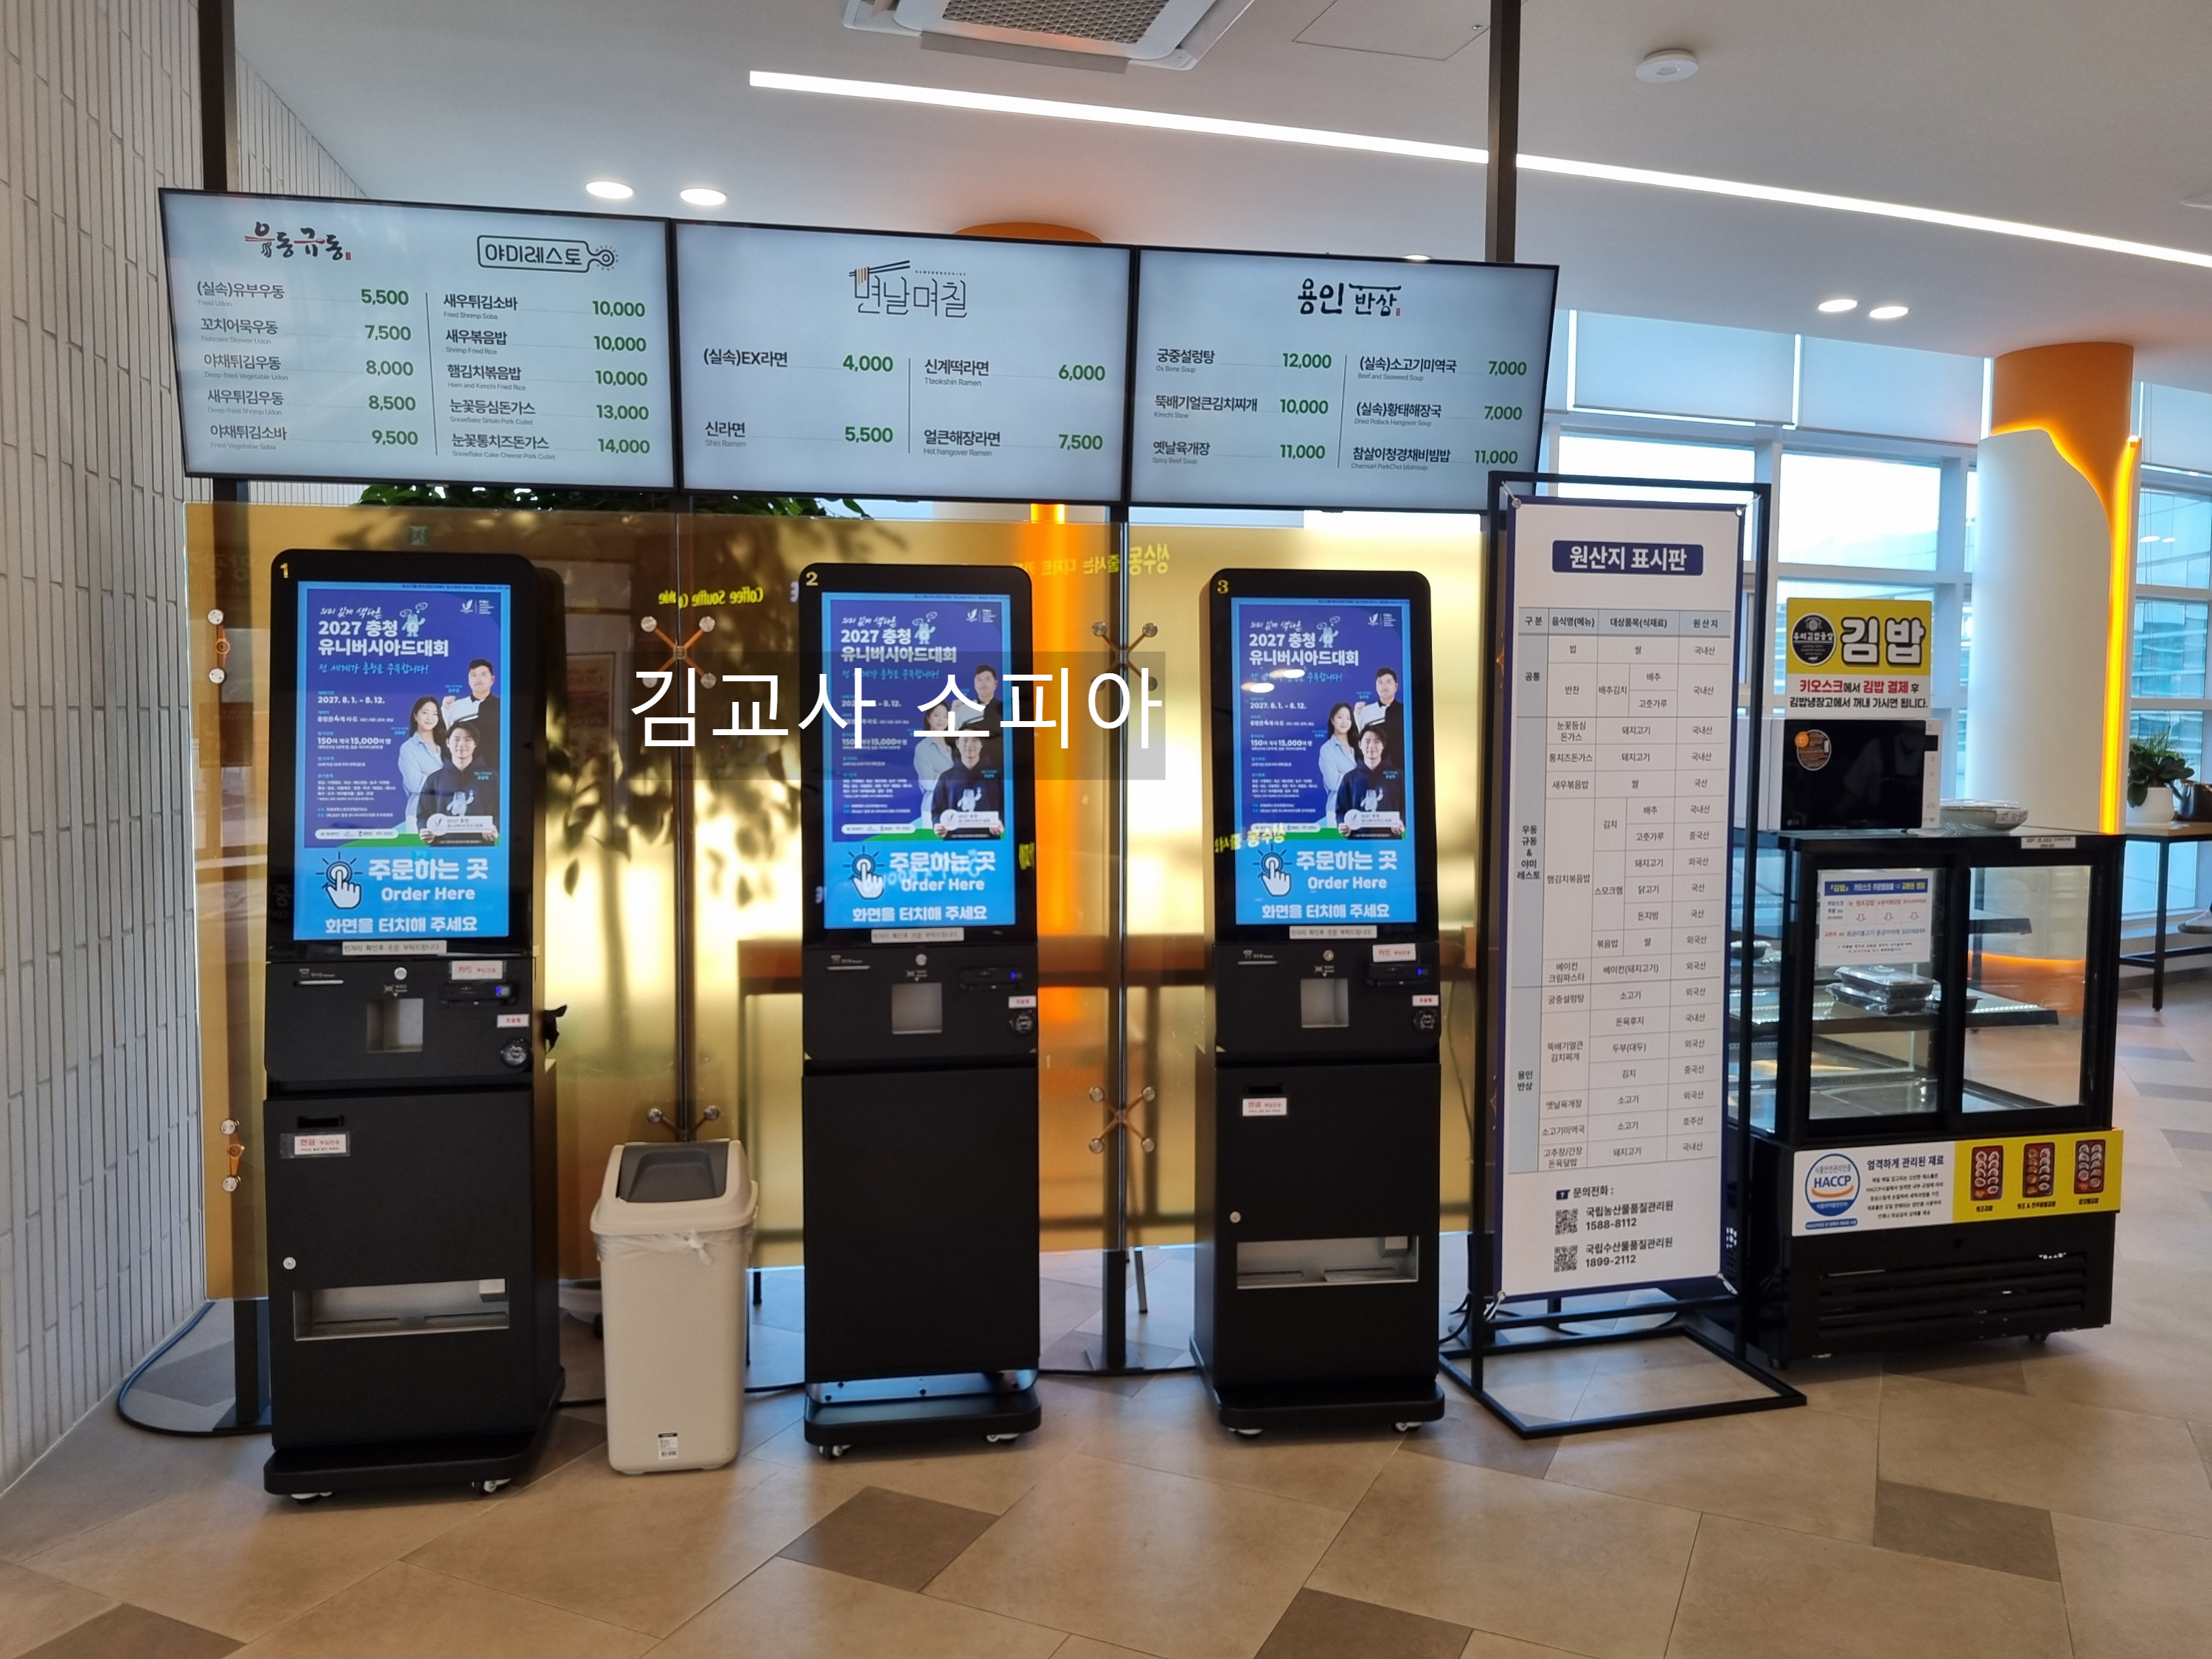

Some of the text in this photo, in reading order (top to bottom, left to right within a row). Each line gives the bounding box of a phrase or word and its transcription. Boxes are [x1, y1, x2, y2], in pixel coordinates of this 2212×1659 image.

[485, 244, 582, 265] 야미레스토
[197, 281, 285, 299] (실속)유부우동
[361, 289, 408, 305] 5,500
[853, 265, 967, 318] 면날며칠
[1298, 278, 1400, 317] 용인 반상
[443, 293, 518, 311] 새우튀김소바
[593, 301, 645, 317] 10,000
[201, 319, 278, 334] 꼬치어묵우동
[365, 325, 411, 341] 7,500
[446, 330, 507, 345] 새우볶음밥
[594, 336, 647, 352] 10,000
[204, 354, 281, 370] 야채튀김우동
[704, 348, 787, 367] (실속)EX라면
[843, 355, 893, 372] 4,000
[1157, 349, 1215, 364] 궁중설렁탕
[1283, 353, 1332, 369] 12,000
[366, 361, 414, 376] 8,000
[448, 364, 521, 380] 햄김치볶음밥
[925, 359, 989, 377] 신계떡라면
[1360, 356, 1457, 373] (실속)소고기미역국
[1489, 361, 1526, 376] 7,000
[596, 370, 647, 386] 10,000
[1059, 364, 1105, 381] 6,000
[208, 390, 284, 406] 새우튀김우동
[369, 395, 416, 411] 8,500
[1155, 395, 1257, 411] 뚝배기얼큰김치찌개
[450, 399, 535, 414] 눈꽃등심돈가스
[597, 405, 649, 420] 13,000
[1280, 399, 1329, 414] 10,000
[1357, 402, 1441, 418] (실속)황태해장국
[1484, 406, 1522, 420] 7,000
[210, 425, 287, 441] 야채튀김소바
[705, 421, 745, 437] 신라면
[845, 426, 893, 443] 5,500
[372, 430, 418, 445] 9,500
[452, 434, 549, 450] 눈꽃통치즈돈가스
[924, 430, 1001, 446] 얼큰해장라면
[1059, 434, 1102, 451] 7,500
[598, 438, 650, 454] 14,000
[1153, 441, 1210, 456] 옛날육개장
[1280, 445, 1325, 459] 11,000
[1353, 448, 1451, 462] 참살이청경채비빔밥
[1475, 451, 1517, 465] 11,000
[1570, 546, 1686, 571] 원산지 표시판
[280, 563, 288, 578] 1
[806, 571, 818, 586] 2
[1217, 580, 1228, 594] 3
[319, 621, 397, 637] 2027 충청
[1551, 616, 1594, 627] 음식명(메뉴)
[1610, 618, 1667, 628] 대상품목(식재료)
[841, 629, 911, 644] 2027 충청
[1249, 633, 1315, 647] 2027 충청
[1841, 616, 1926, 666] 김밥
[319, 639, 448, 657] 유니버시아드대회
[841, 647, 956, 663] 유니버시아드대회
[1569, 644, 1576, 653] 밥
[1694, 646, 1715, 655] 국내산
[1249, 650, 1358, 666] 유니버시아드대회
[1525, 672, 1540, 681] 공통
[1646, 672, 1660, 681] 배추
[1565, 686, 1579, 695] 반찬
[1599, 685, 1627, 695] 배추김치
[1693, 686, 1714, 695] 국내산
[1800, 680, 1919, 693] 키오스크에서 김밥 결제 후
[1639, 700, 1667, 709] 고춧가루
[1790, 698, 1927, 709] 김밥냉장고에서 꺼내 가시면 됩니다.
[1557, 721, 1586, 731] 눈꽃등심
[1622, 726, 1651, 735] 돼지고기
[1692, 726, 1712, 734] 국내산
[1561, 732, 1582, 742] 돈가스
[1549, 753, 1593, 762] 통치즈돈가스
[1621, 753, 1650, 762] 돼지고기
[1691, 752, 1711, 761] 국내산
[1694, 779, 1707, 787] 국산
[1296, 850, 1397, 871] 주문하는 곳
[1526, 849, 1532, 858] &
[369, 858, 488, 880] 주문하는 곳
[890, 851, 995, 872] 주문하는 곳
[902, 878, 984, 891] Order Here
[1308, 877, 1386, 889] Order Here
[381, 887, 475, 901] Order Here
[852, 906, 987, 922] 화면을 터치해 주세요
[1262, 904, 1389, 918] 화면을 터치해 주세요
[325, 917, 478, 933] 화면을 터치해 주세요
[1517, 1071, 1532, 1079] 용인
[1517, 1082, 1532, 1091] 반상
[1867, 1155, 1944, 1170] 엄격하게 관리된 재료
[1815, 1175, 1851, 1188] HACCP
[1573, 1186, 1607, 1198] 문의전화
[1586, 1200, 1674, 1217] 국립농산물품질관리원
[1586, 1218, 1637, 1231] 1588-8112
[1585, 1237, 1672, 1254] 국립수산물품질관리원
[1586, 1255, 1636, 1267] 1899-2112
